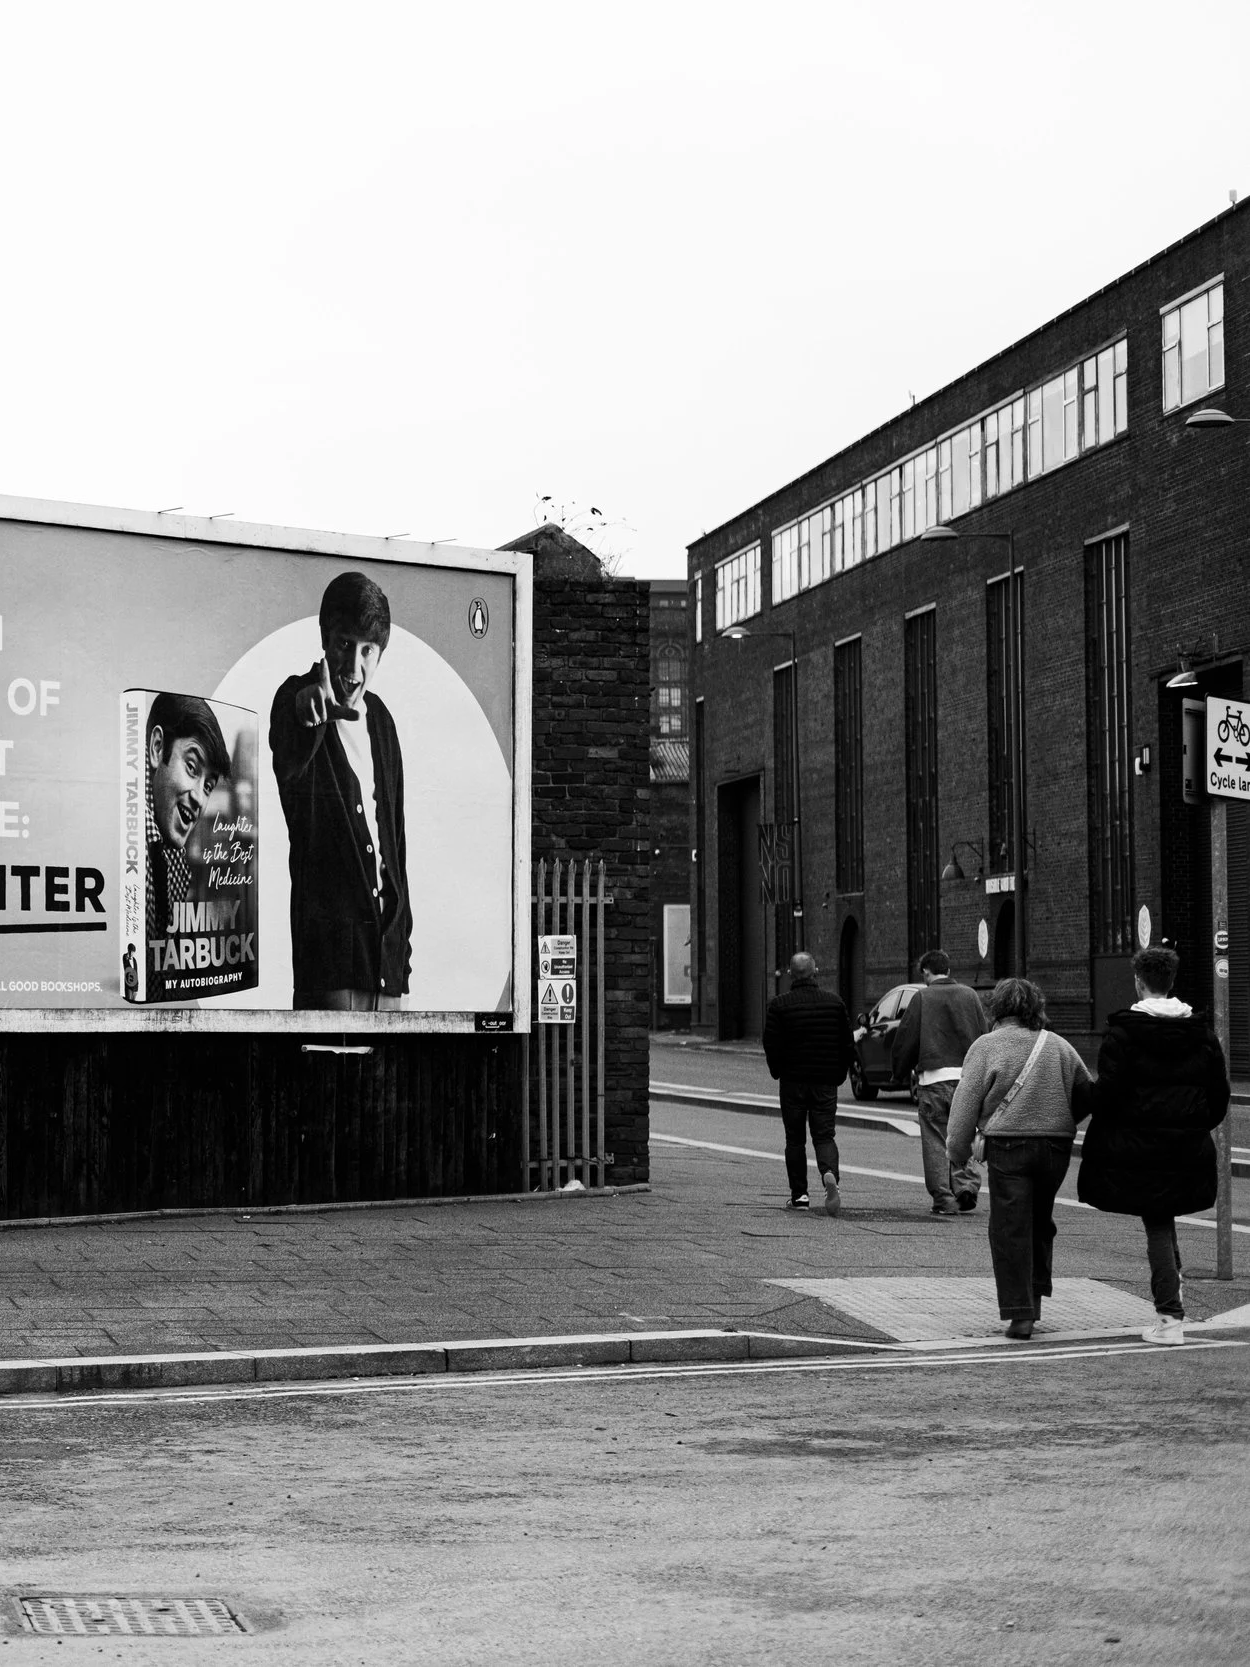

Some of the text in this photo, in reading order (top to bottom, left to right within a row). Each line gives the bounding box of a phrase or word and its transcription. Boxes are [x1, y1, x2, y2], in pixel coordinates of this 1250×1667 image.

[7, 677, 62, 716] OF
[125, 702, 139, 875] JIMMY TARBUCK
[1210, 772, 1236, 790] Cycle
[212, 811, 253, 842] Laughter
[202, 841, 255, 865] is the Best
[208, 866, 254, 890] Medicine
[166, 899, 241, 934] JIMMY
[148, 932, 256, 971] TARBUCK
[8, 981, 39, 992] GOOD
[40, 981, 104, 993] BOOKSHOPS.
[165, 971, 243, 990] MY AUTOBIOGRAPHY
